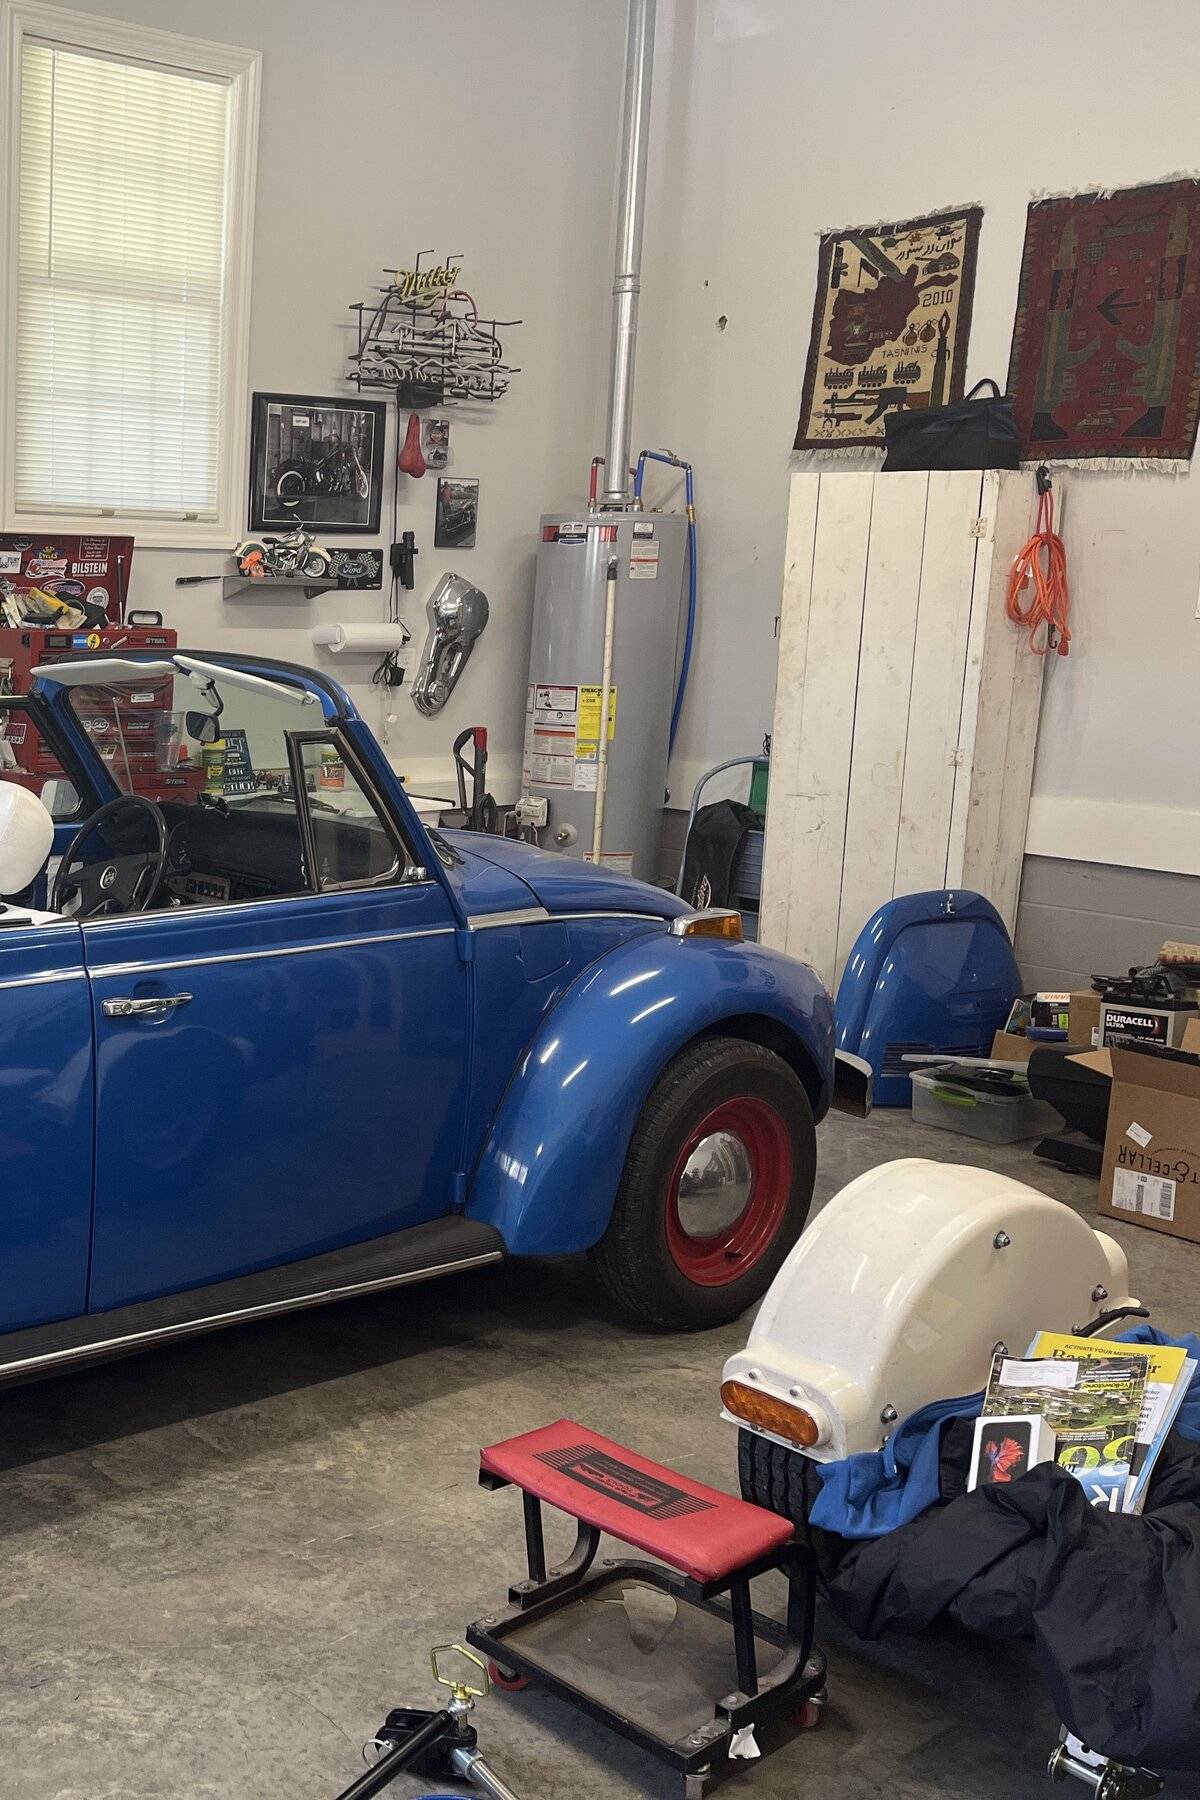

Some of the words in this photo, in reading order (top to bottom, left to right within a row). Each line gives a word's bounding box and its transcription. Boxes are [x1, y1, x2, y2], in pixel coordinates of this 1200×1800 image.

[922, 289, 954, 308] 2010
[71, 562, 108, 574] BILSTEIN
[343, 562, 362, 574] Ford
[1106, 1014, 1153, 1028] DURACELL
[1106, 1021, 1125, 1029] ULTRA
[1118, 1145, 1170, 1175] CELLAR
[1064, 1344, 1094, 1352] ACTIVATE
